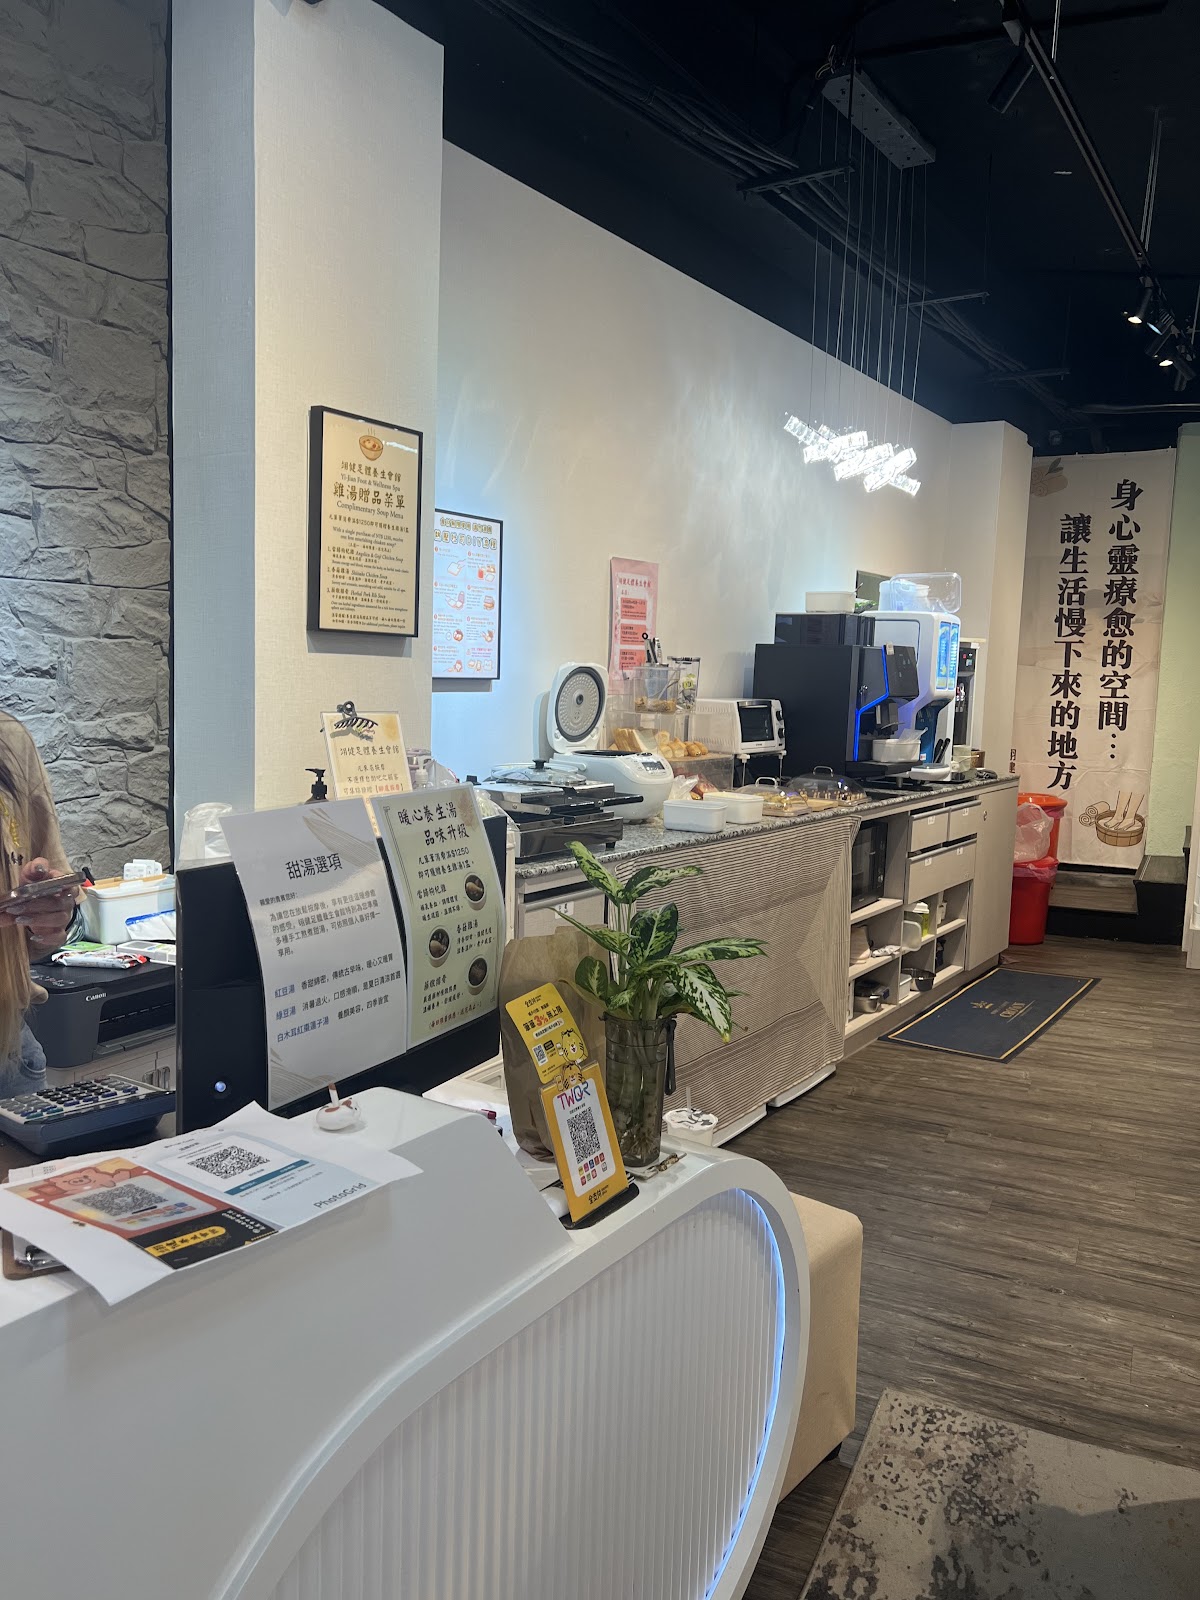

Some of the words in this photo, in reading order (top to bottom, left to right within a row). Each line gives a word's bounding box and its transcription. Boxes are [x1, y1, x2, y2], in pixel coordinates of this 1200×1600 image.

[358, 476, 367, 486] Foot
[373, 480, 391, 490] Wellness
[333, 481, 406, 510] 雞湯贈品菜單
[336, 500, 376, 516] Complimentary
[377, 508, 389, 518] Soup
[390, 511, 404, 520] Menu
[356, 530, 372, 538] purchase
[373, 538, 386, 546] chicken
[395, 556, 404, 564] Soup
[1047, 513, 1092, 790] 讓生活慢下來的地方
[398, 802, 457, 826] 暖心養生湯
[424, 823, 470, 846] 品味升級
[285, 852, 343, 880] 甜湯選項
[85, 992, 106, 1001] Canon
[274, 984, 295, 999] 紅豆湯
[276, 1006, 297, 1021] 綠豆湯
[277, 1016, 329, 1043] 白木耳紅棗蓮子湯
[557, 1080, 591, 1110] TWQR
[313, 1182, 366, 1209] PhotoGrid
